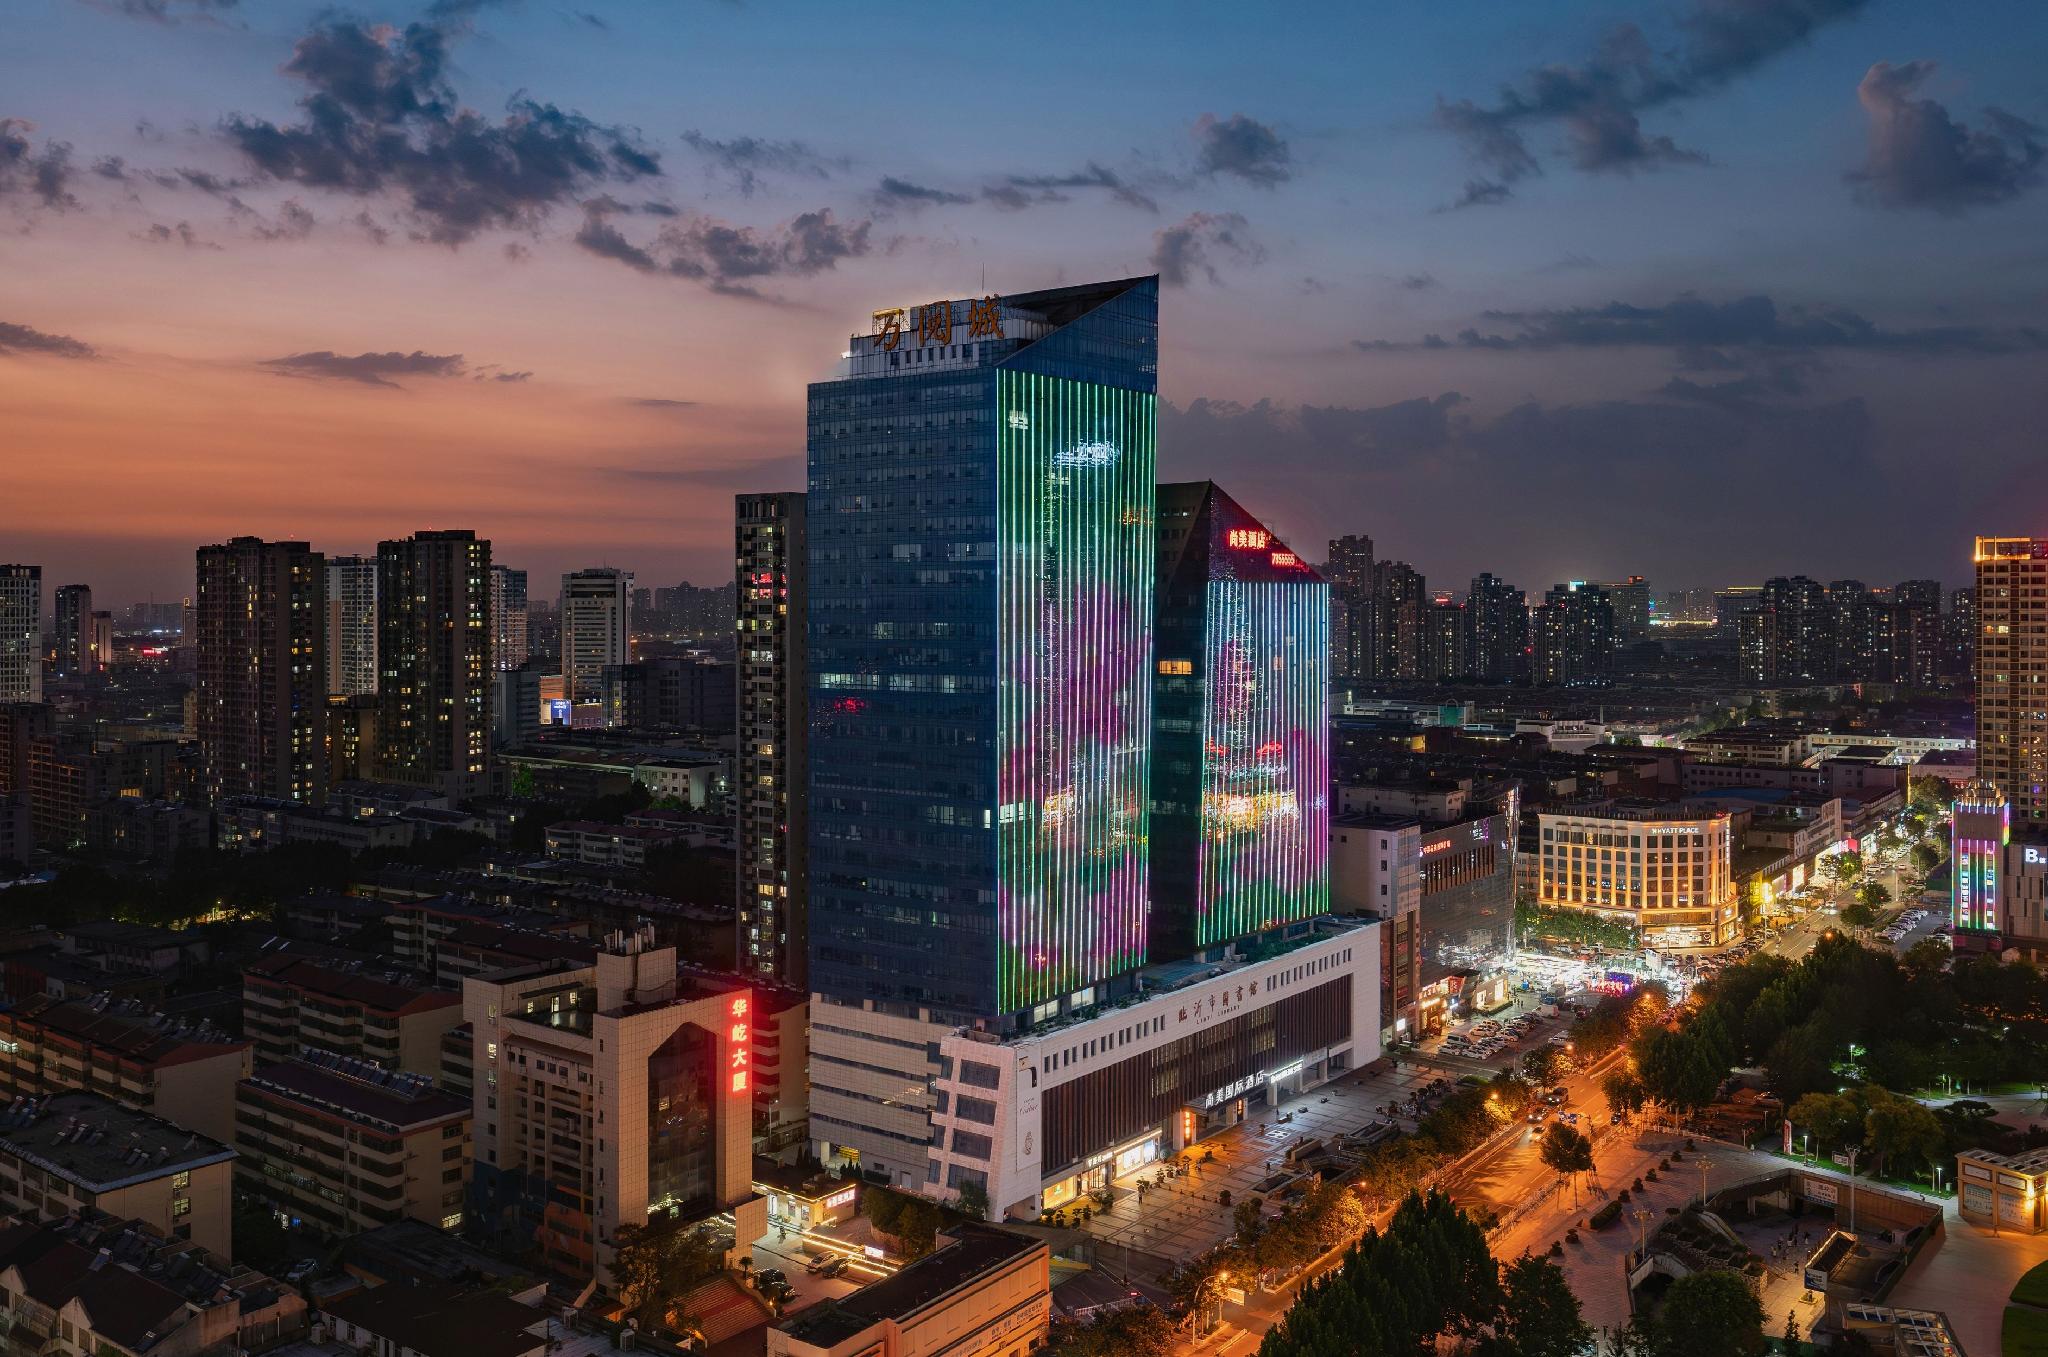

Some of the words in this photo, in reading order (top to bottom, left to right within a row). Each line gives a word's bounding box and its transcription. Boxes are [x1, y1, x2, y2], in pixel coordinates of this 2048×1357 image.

[1229, 529, 1266, 548] 尚美酒店
[1205, 1069, 1264, 1108] 尚美国际酒店
